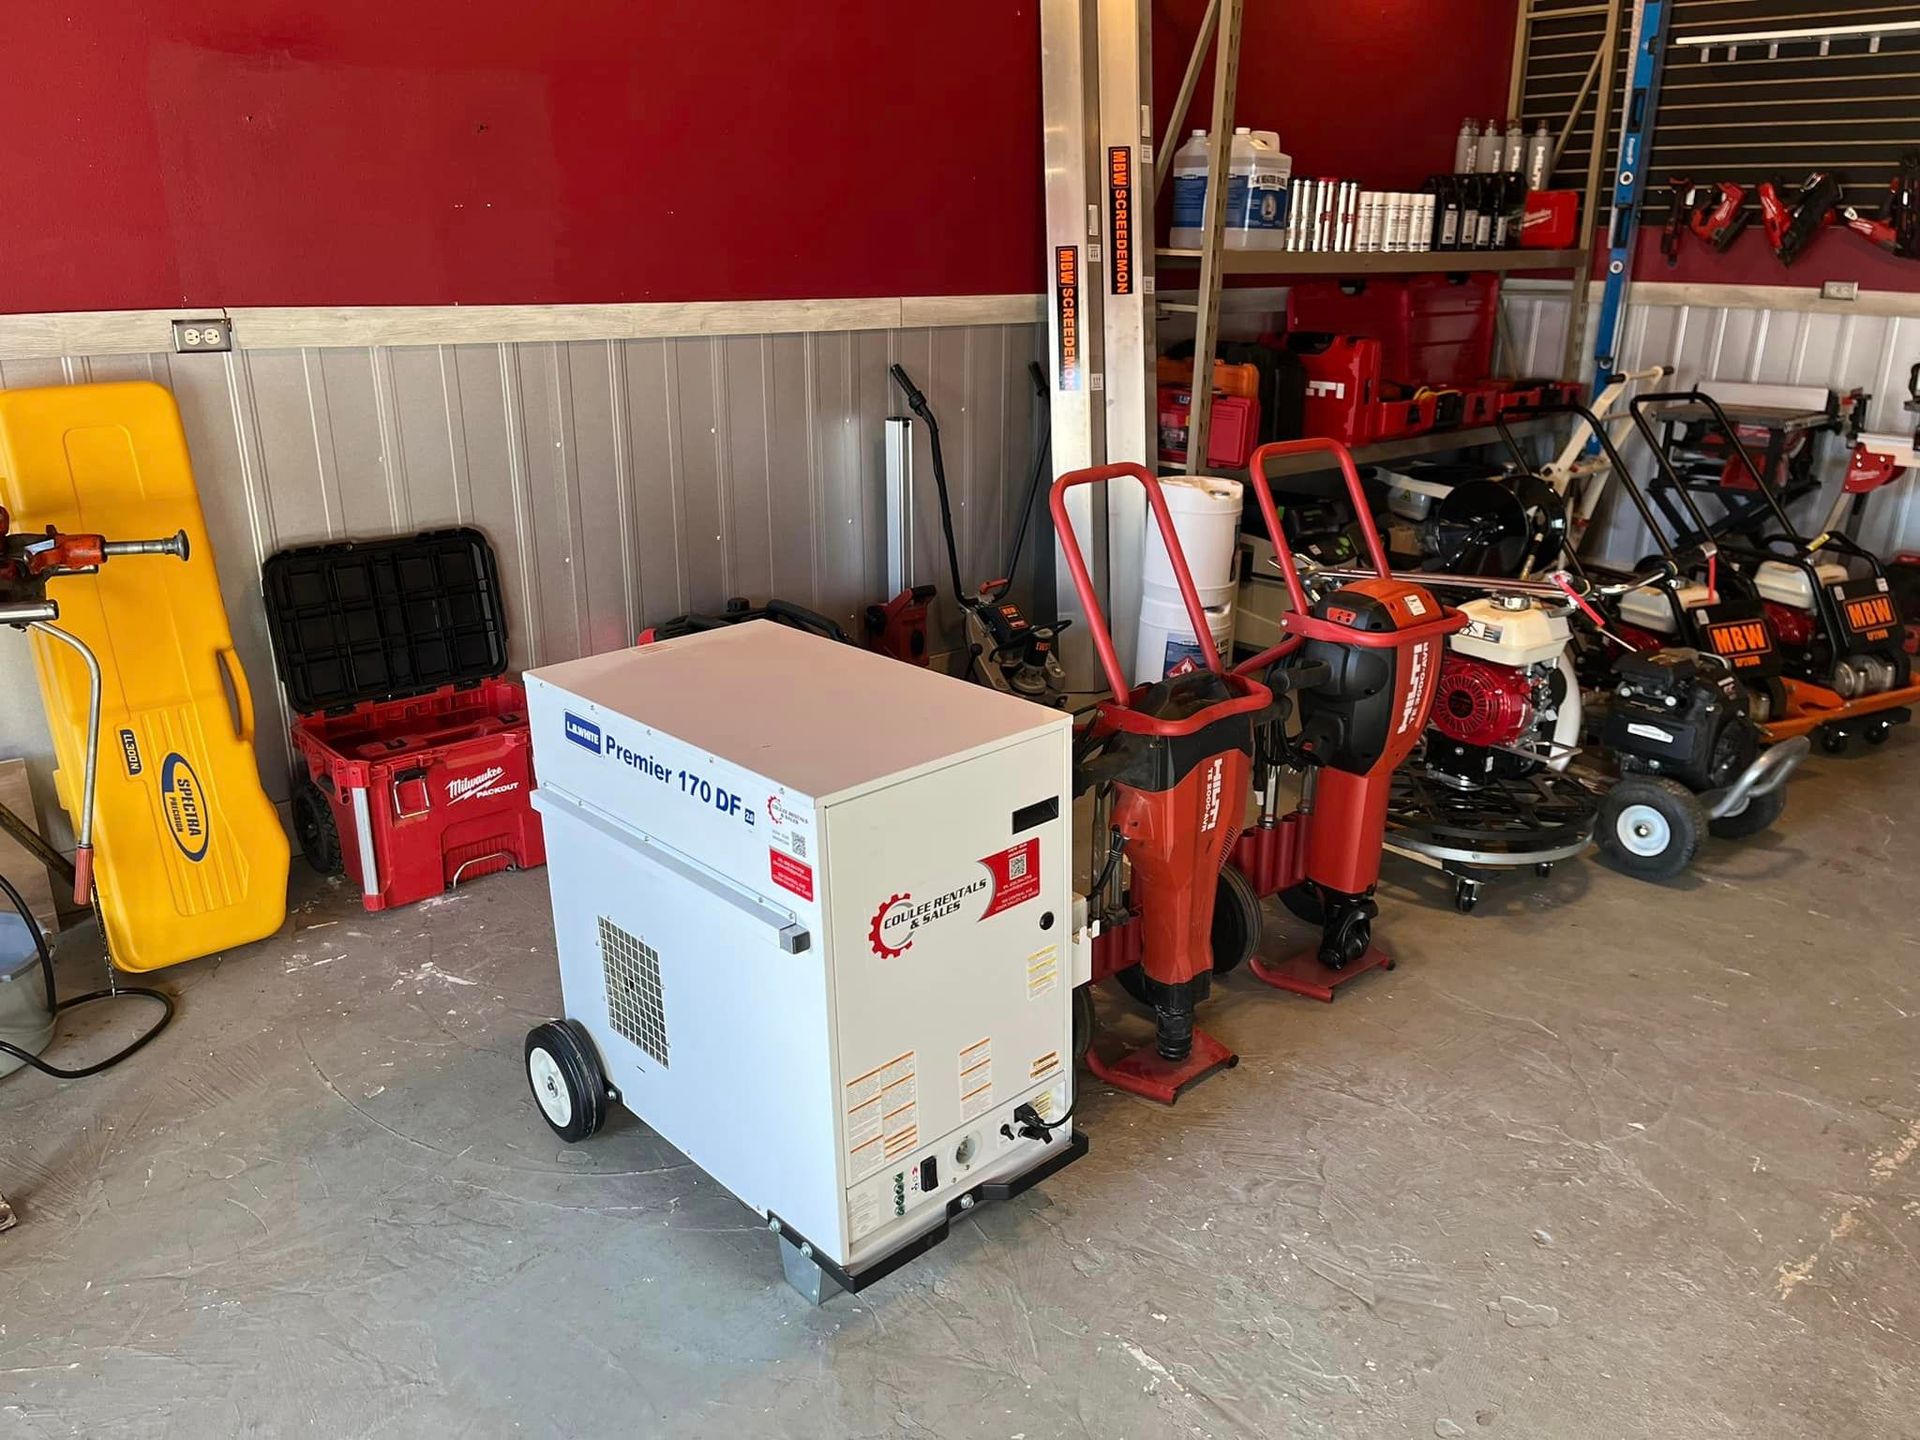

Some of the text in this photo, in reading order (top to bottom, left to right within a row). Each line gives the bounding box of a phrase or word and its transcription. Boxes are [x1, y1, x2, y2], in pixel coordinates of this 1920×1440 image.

[1112, 150, 1128, 293] MBW SCREEDEMON
[1059, 249, 1075, 391] MBW SCREEDEMON
[1712, 623, 1766, 654] MBW
[1847, 597, 1893, 629] MBW
[1396, 643, 1423, 735] HILTI
[445, 766, 503, 799] Milwaukee
[476, 782, 519, 799] PACKOUT
[606, 734, 672, 784] Premier
[678, 770, 711, 803] 170
[715, 787, 742, 816] DF
[1207, 758, 1223, 830] HILTI
[177, 779, 202, 837] SPECTRA
[884, 900, 931, 930] COULEE
[933, 879, 987, 909] RENTALS
[910, 900, 961, 930] & SALES
